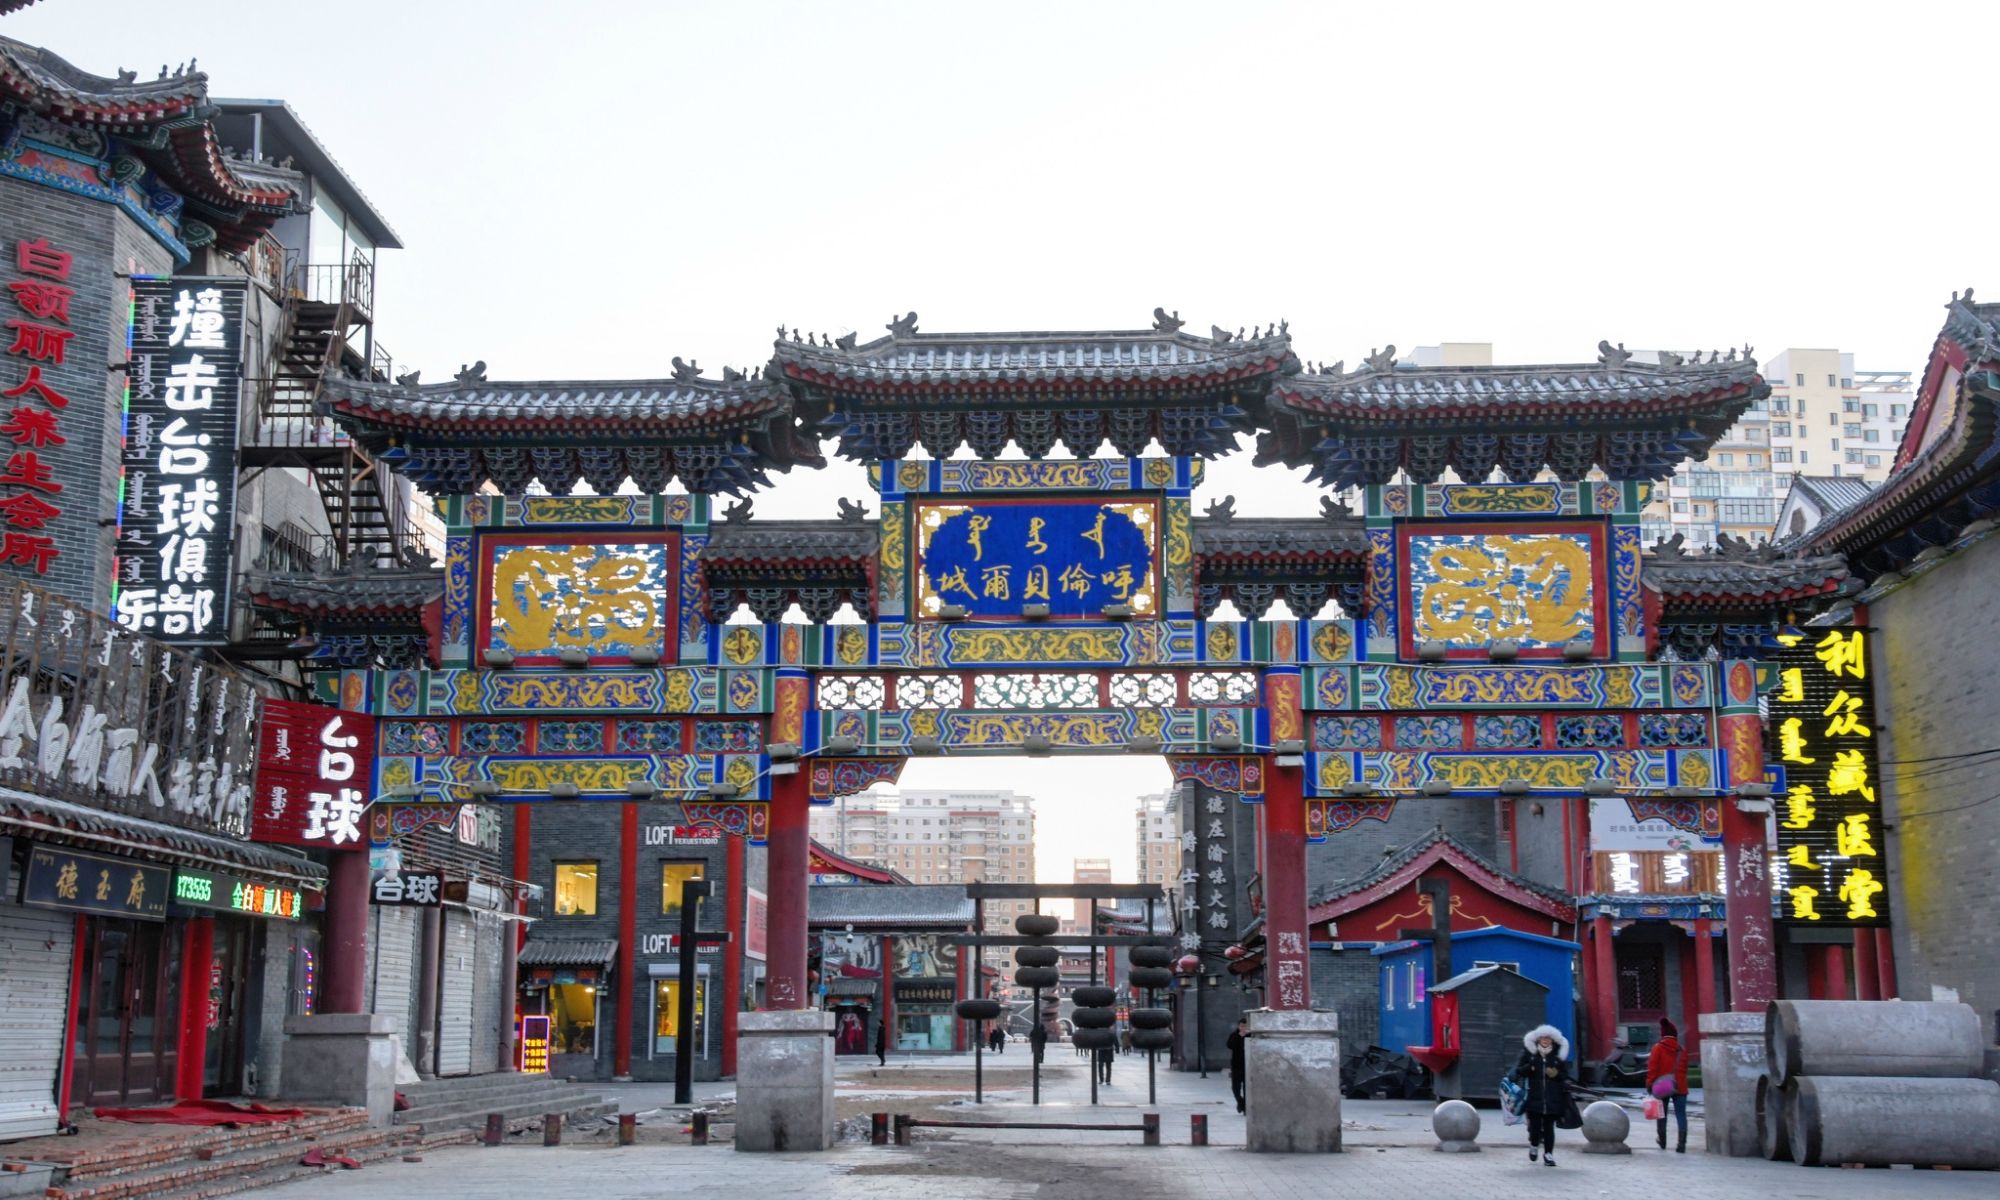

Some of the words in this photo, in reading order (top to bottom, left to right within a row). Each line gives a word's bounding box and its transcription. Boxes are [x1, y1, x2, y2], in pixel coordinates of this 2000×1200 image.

[0, 237, 76, 576] 白领丽人养生会所
[117, 287, 227, 636] 撞击台球俱乐部
[303, 716, 364, 845] 台球
[645, 826, 674, 845] LOFT
[1815, 630, 1883, 920] 利众藏医堂
[375, 875, 439, 903] 台球
[643, 935, 672, 954] LOFT
